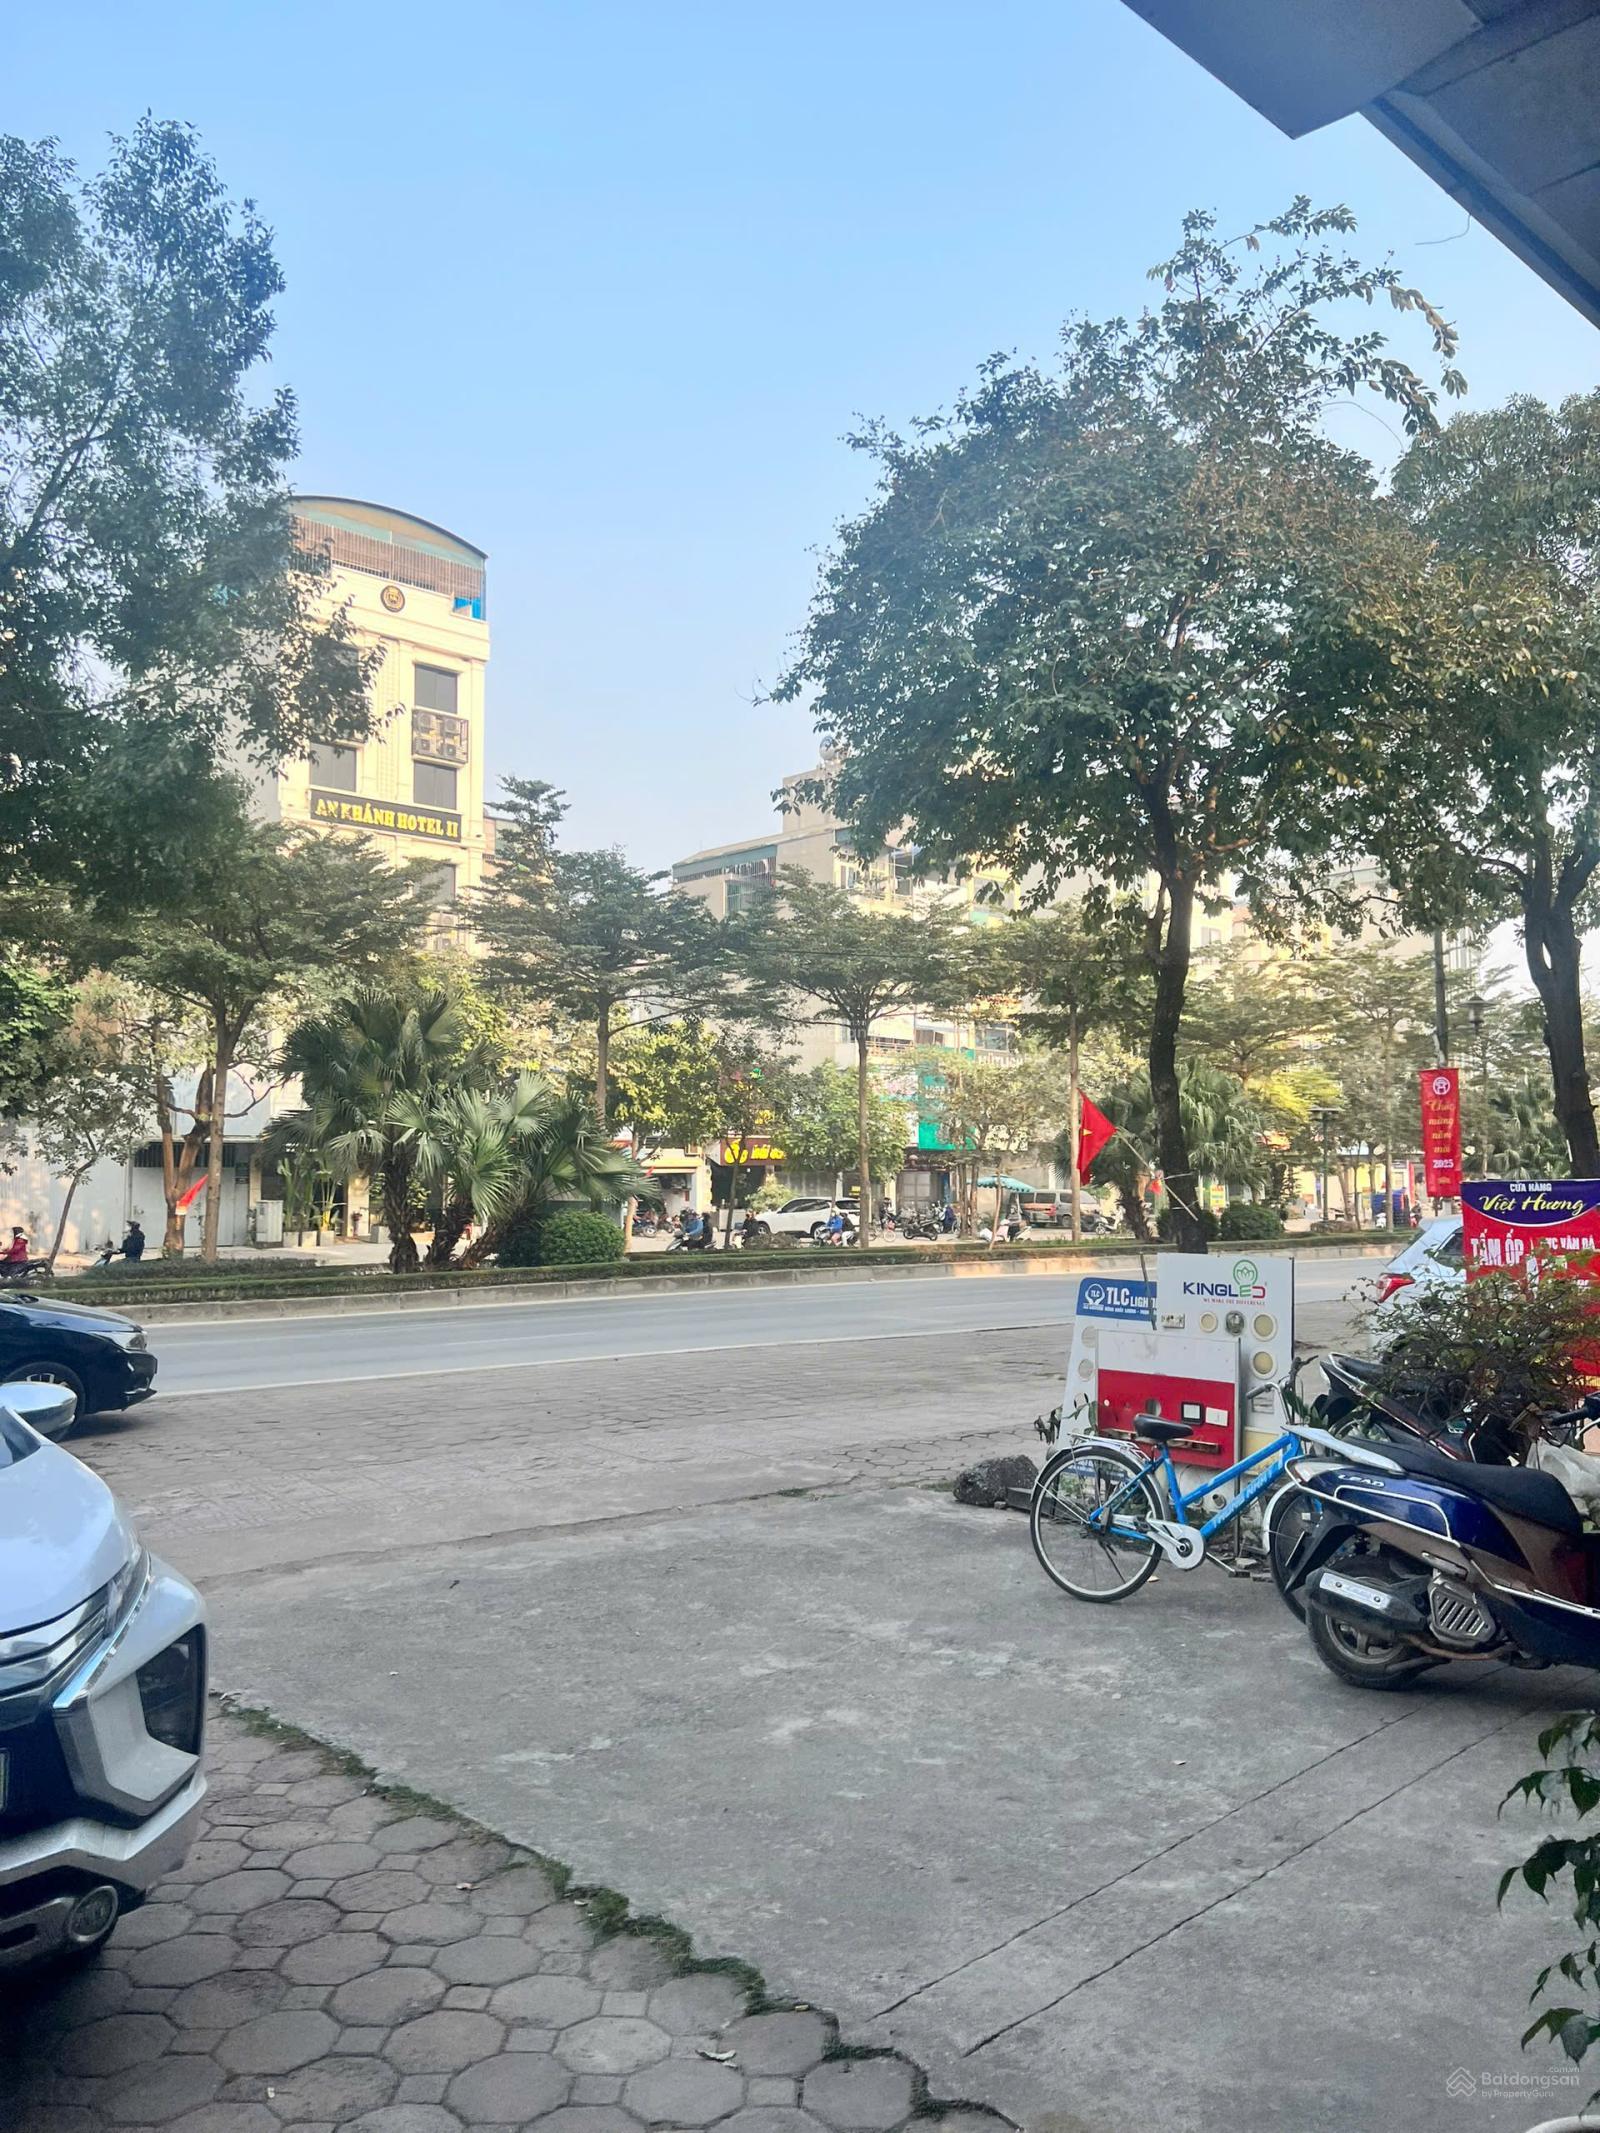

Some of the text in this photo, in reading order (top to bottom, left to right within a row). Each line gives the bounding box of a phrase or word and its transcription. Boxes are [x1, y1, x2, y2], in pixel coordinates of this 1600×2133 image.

[315, 799, 458, 837] AN KHÁNH HOTEL II
[1432, 1160, 1454, 1168] 2025
[1529, 1182, 1552, 1192] HÀNG
[1479, 1193, 1584, 1216] Việt Hương
[1505, 1229, 1524, 1265] ỐP
[1106, 1286, 1130, 1306] TLC
[1183, 1281, 1265, 1299] KINGLED
